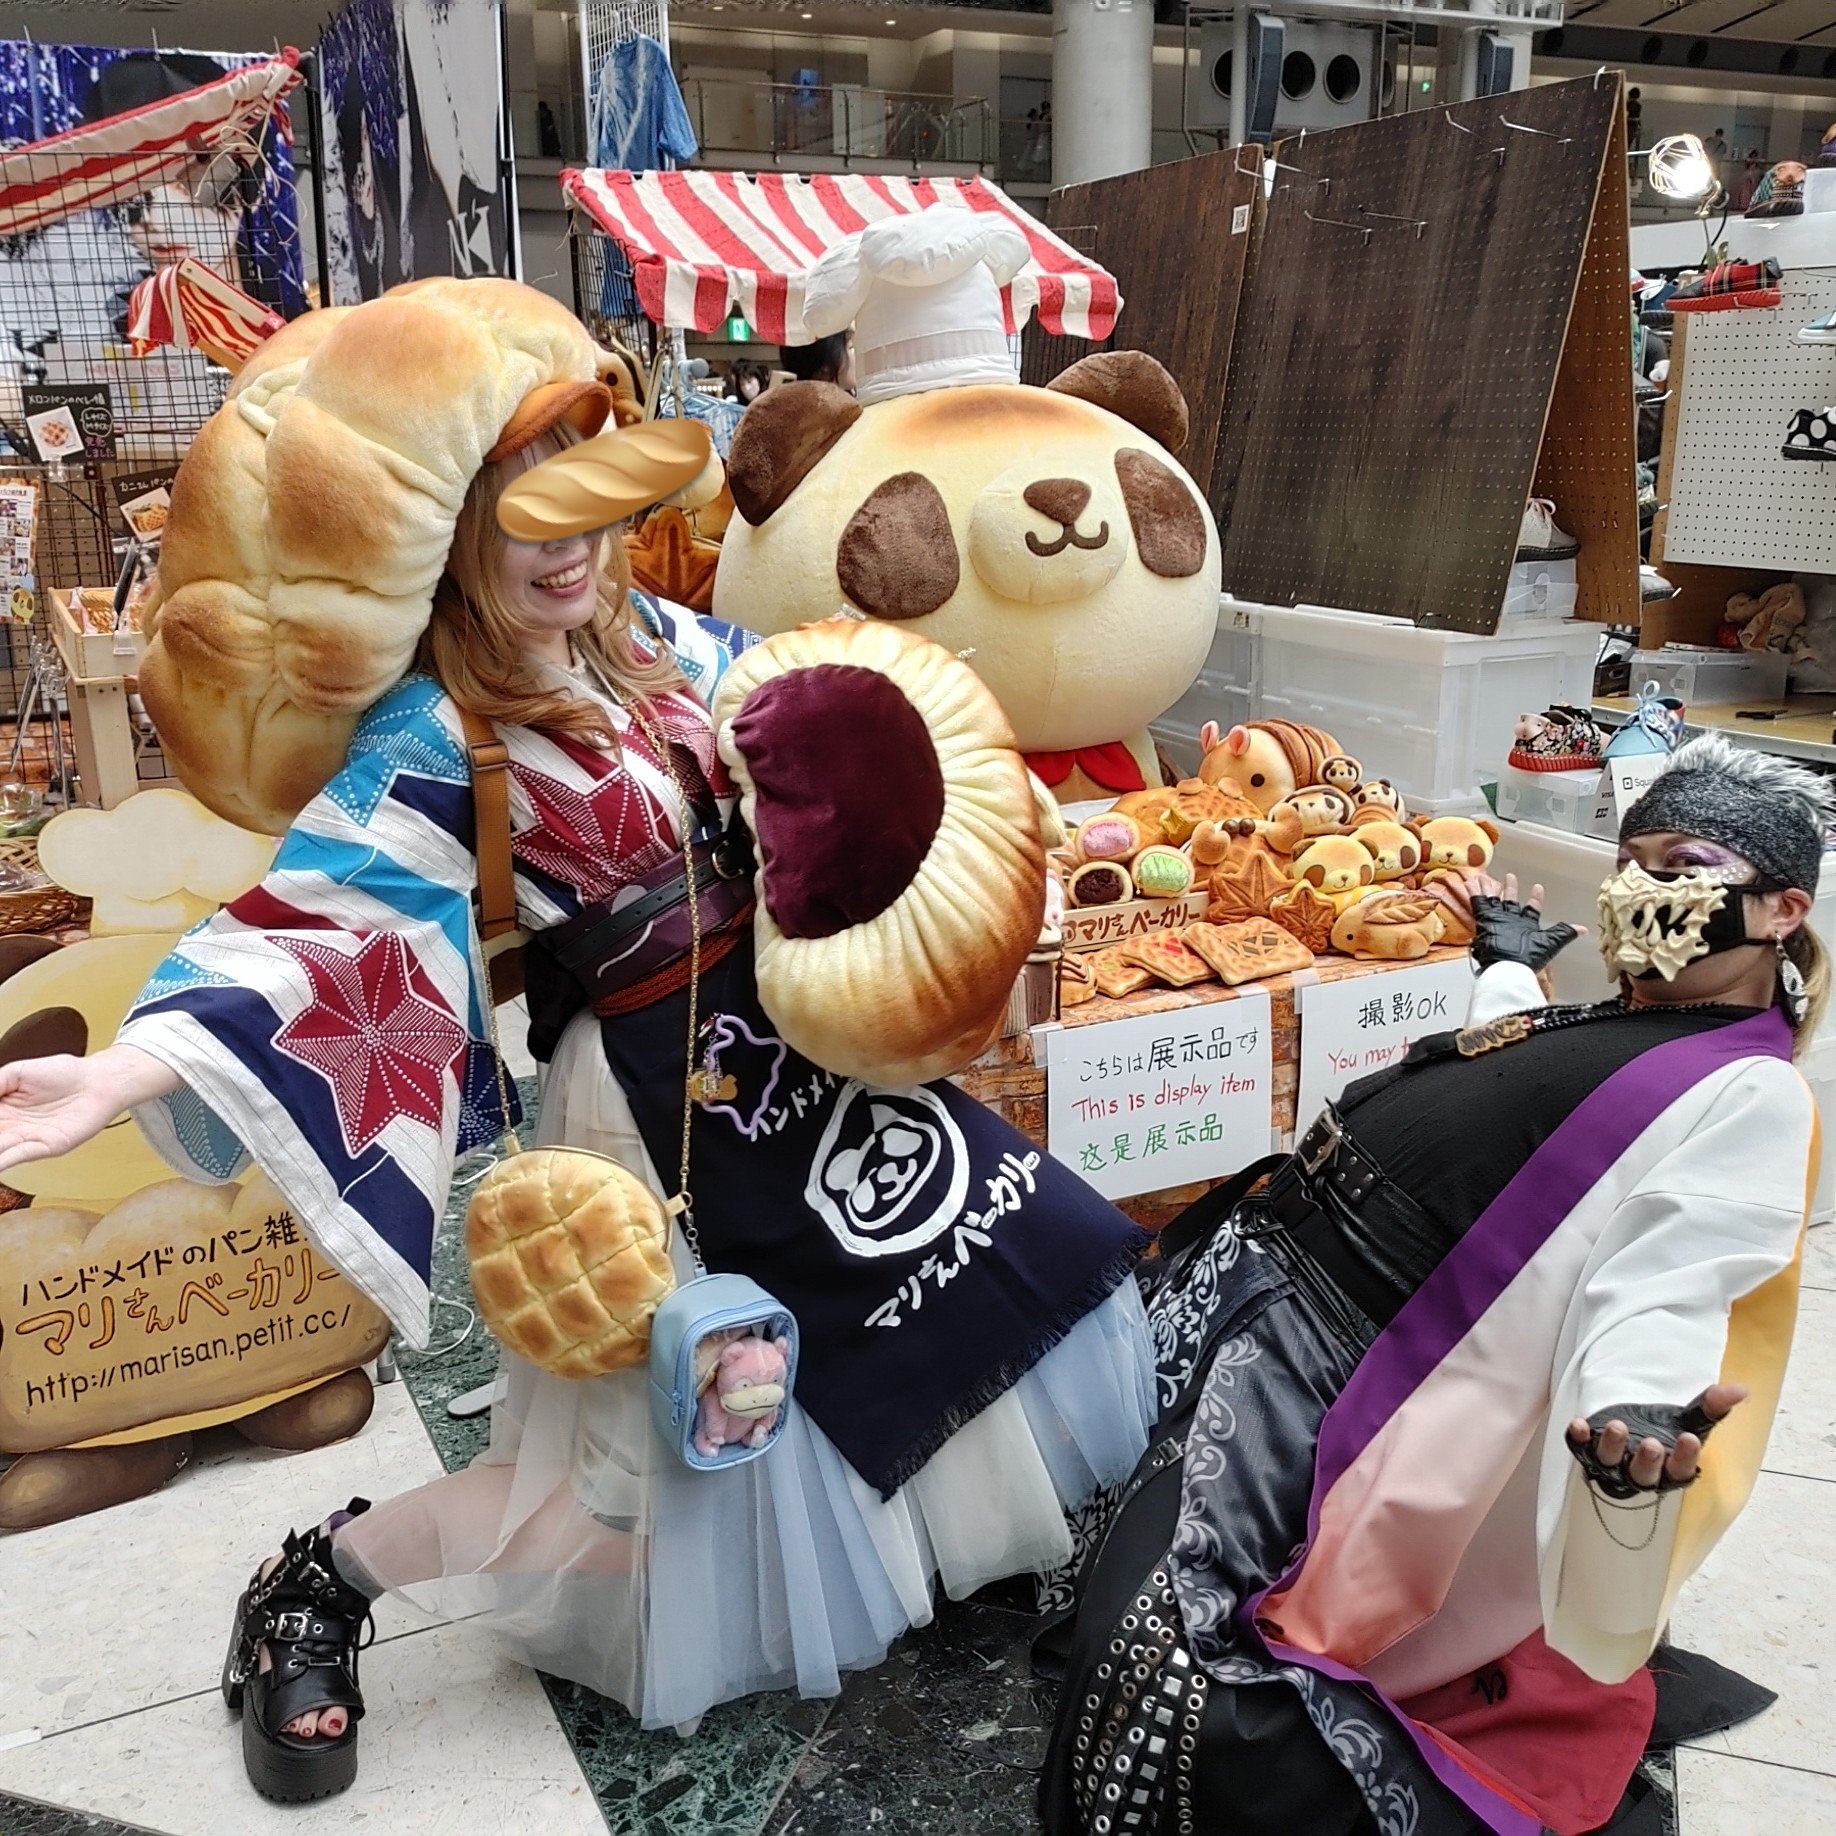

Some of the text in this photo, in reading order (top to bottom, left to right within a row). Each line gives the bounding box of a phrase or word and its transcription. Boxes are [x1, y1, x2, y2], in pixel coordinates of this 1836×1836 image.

[1078, 903, 1200, 940] マリさんベーカリー
[1357, 990, 1447, 1029] 撮影OK
[1079, 1027, 1259, 1082] こちらは展示品です
[1328, 1043, 1358, 1075] You
[1365, 1045, 1398, 1075] may
[1073, 1074, 1255, 1123] This is display item
[1079, 1113, 1224, 1173] 这是展示品
[22, 1211, 309, 1307] ハンドメイドのパン雑
[864, 1151, 1041, 1328] マリさんベーカリー
[16, 1247, 343, 1356] マリさんベーカリー
[25, 1304, 352, 1408] http://marisan.petit.cc/
